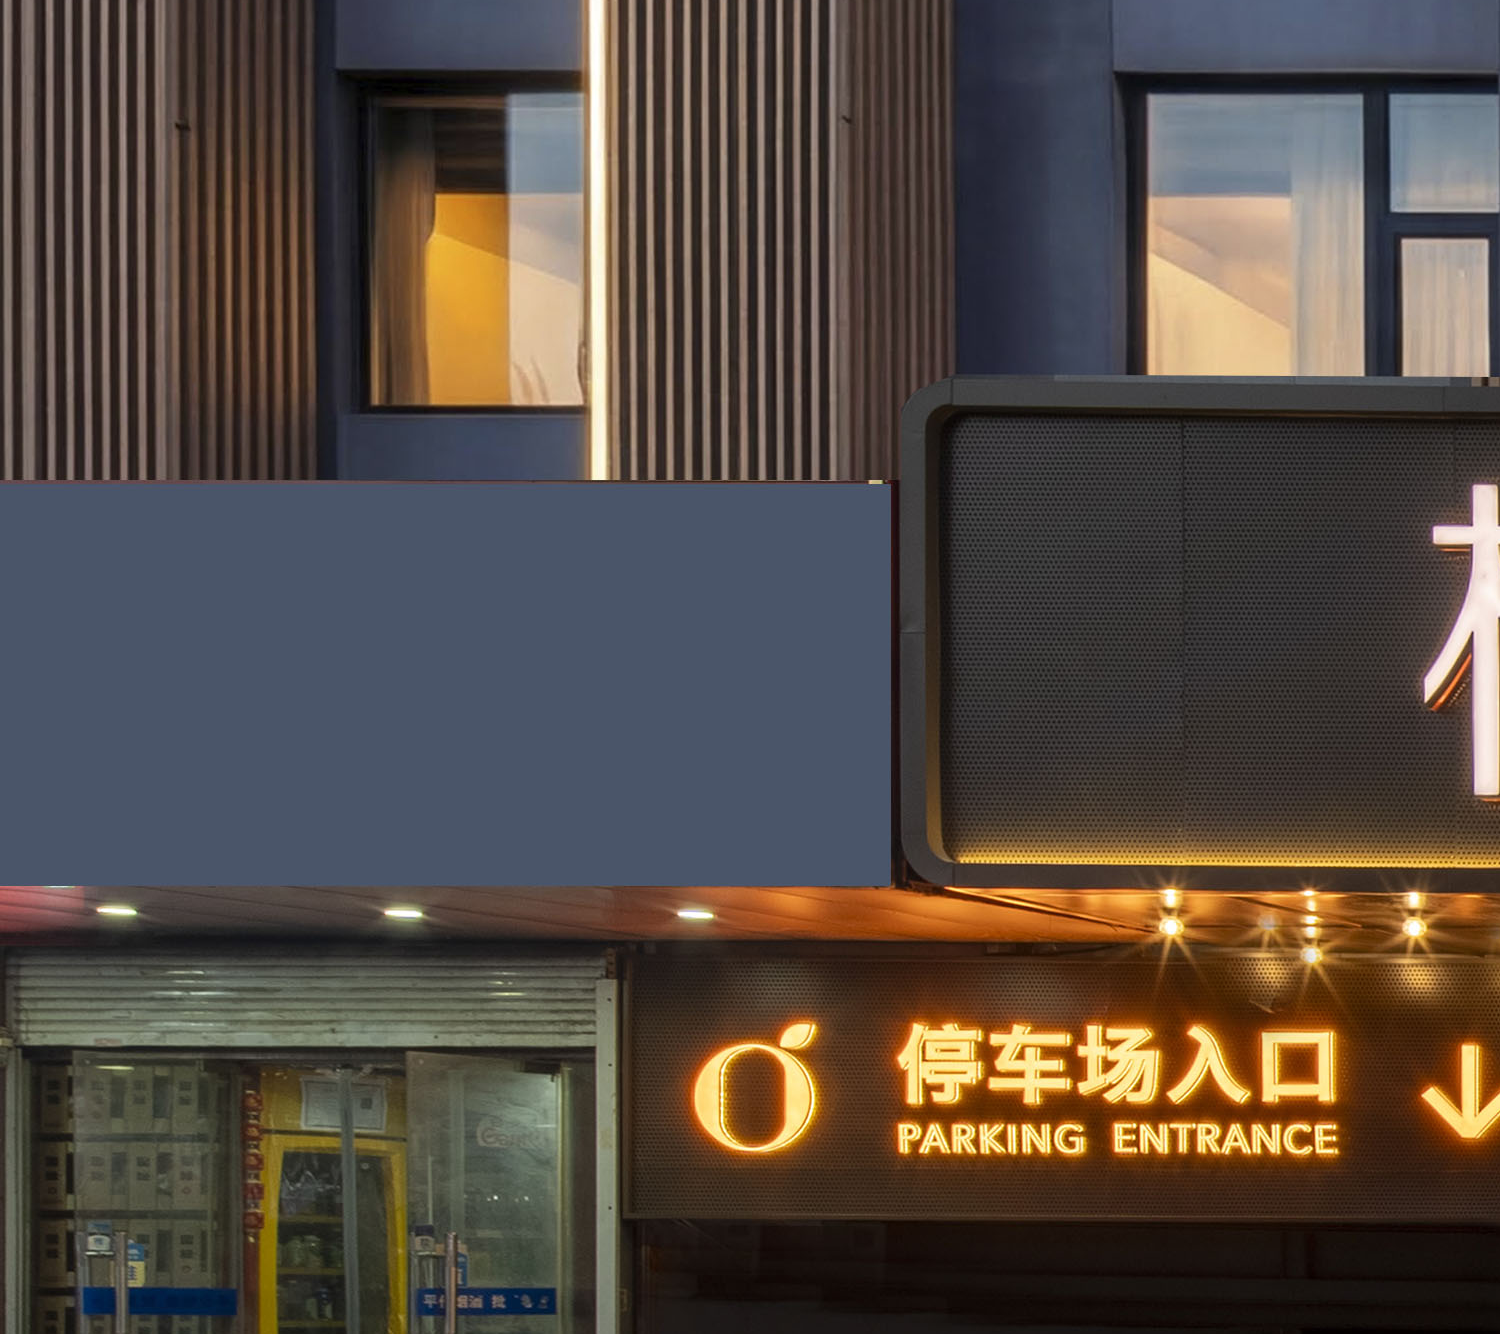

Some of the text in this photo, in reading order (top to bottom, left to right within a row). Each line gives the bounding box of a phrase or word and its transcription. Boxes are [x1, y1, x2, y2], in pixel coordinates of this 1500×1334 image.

[898, 1023, 1338, 1105] 停车场入口
[897, 1122, 1339, 1156] PARKING ENTRANCE
